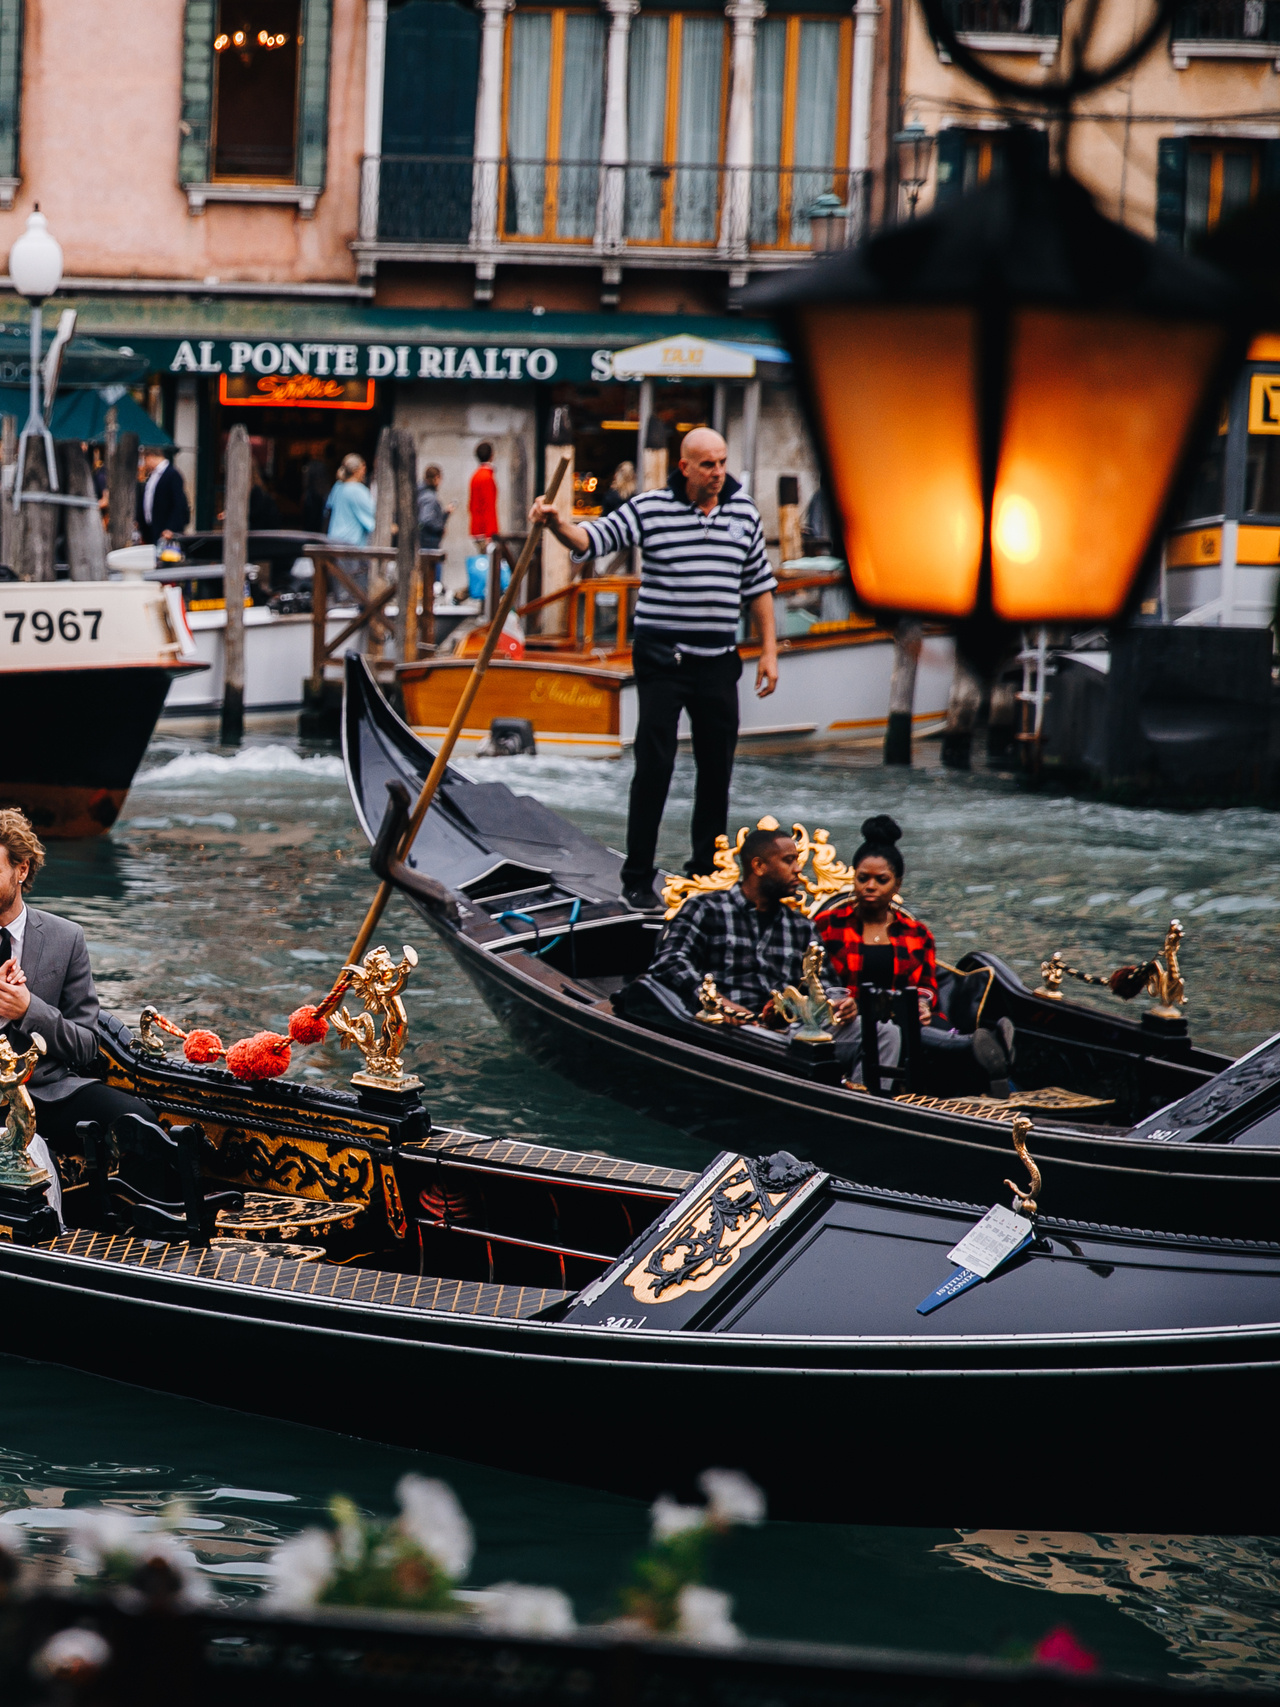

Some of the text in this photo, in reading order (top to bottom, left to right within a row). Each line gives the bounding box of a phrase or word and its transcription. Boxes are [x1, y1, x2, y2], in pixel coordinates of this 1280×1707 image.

[169, 340, 222, 373] AL
[228, 341, 359, 376] PONTE
[366, 345, 411, 378] DI
[417, 345, 559, 380] RIALTO
[4, 609, 103, 643] 7967
